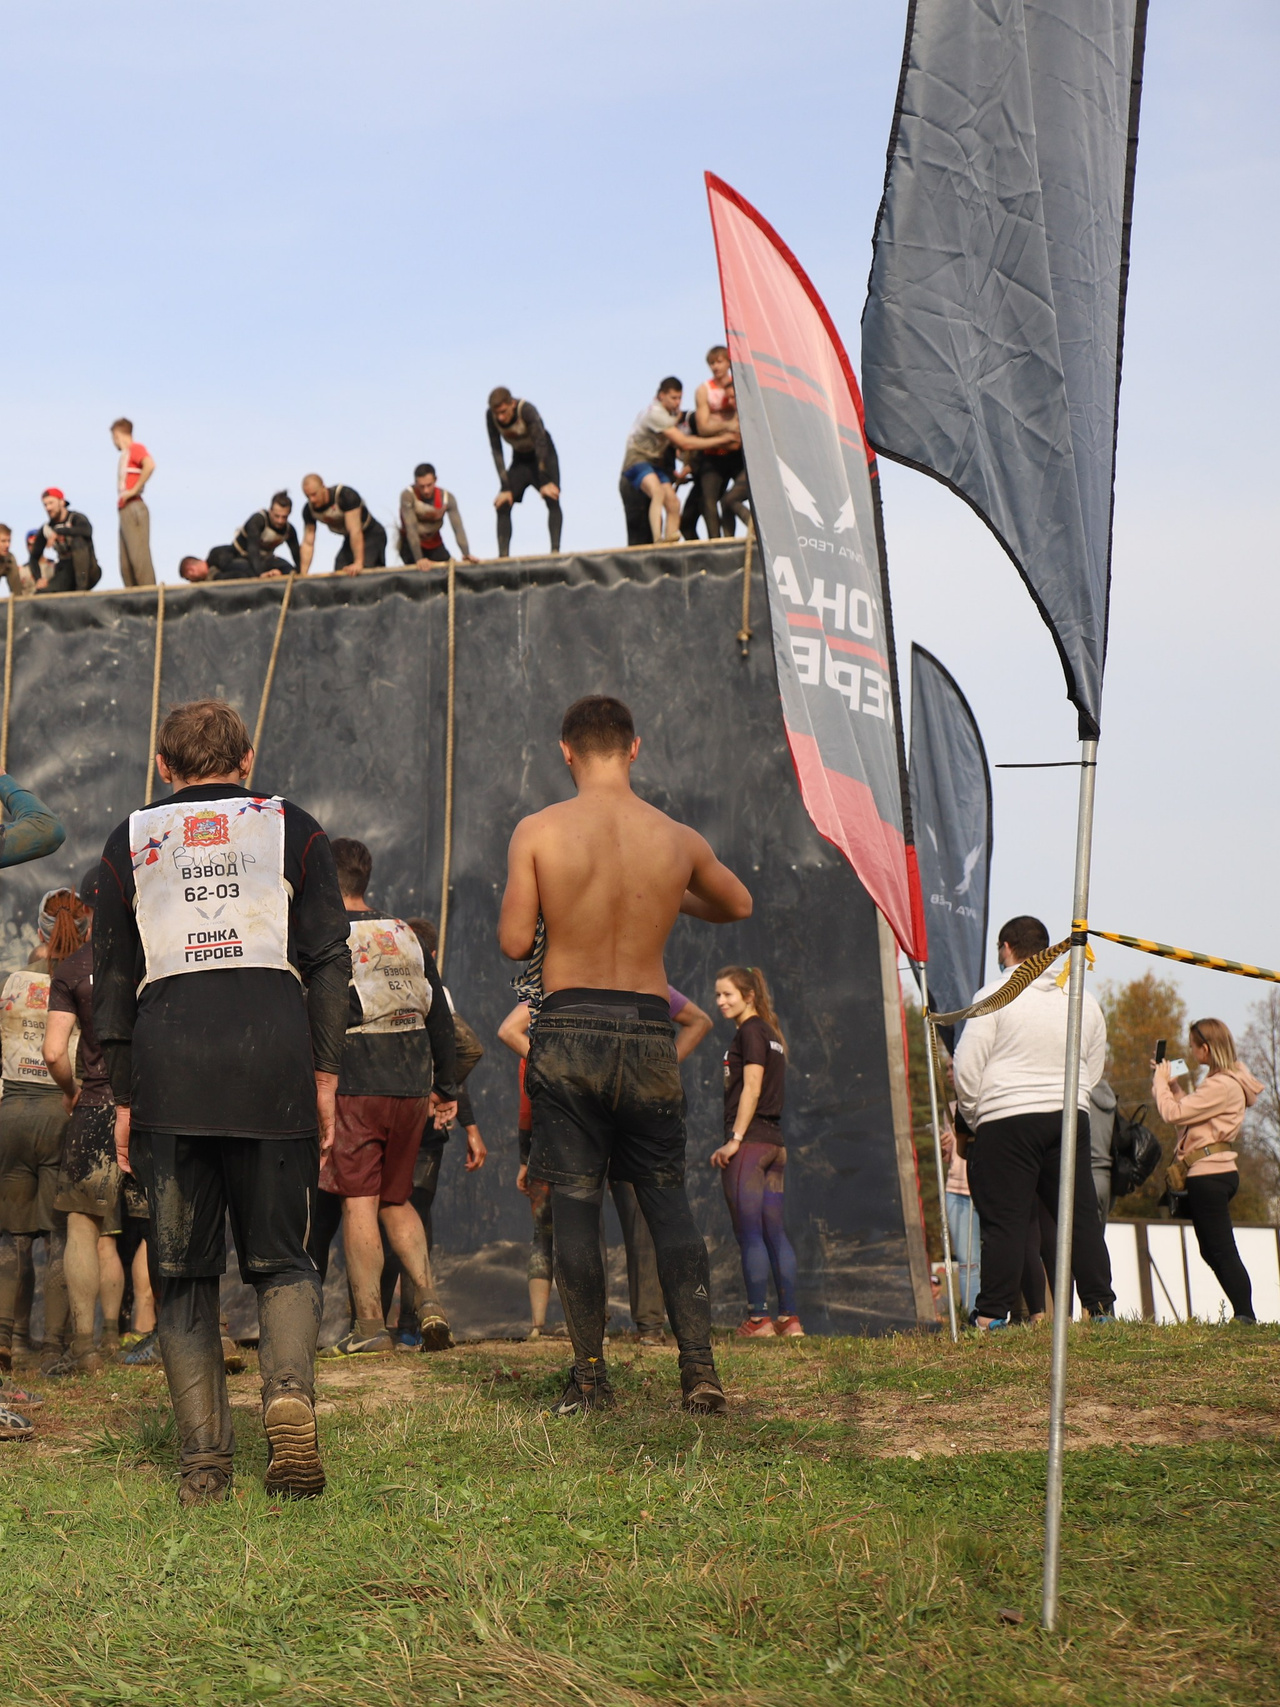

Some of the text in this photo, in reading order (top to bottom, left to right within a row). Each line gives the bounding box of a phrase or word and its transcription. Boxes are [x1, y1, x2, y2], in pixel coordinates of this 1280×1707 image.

[182, 863, 238, 880] ВЗВОД
[184, 883, 240, 902] 62-03
[187, 928, 239, 945] ГОНКА
[185, 945, 243, 963] ГЕРОЕВ
[383, 967, 411, 977] ВЗВОД
[388, 980, 415, 991] 62-11
[22, 1019, 46, 1029] ВЗВО
[23, 1031, 45, 1041] 62-1
[17, 1067, 48, 1077] ГЕРОЕВ
